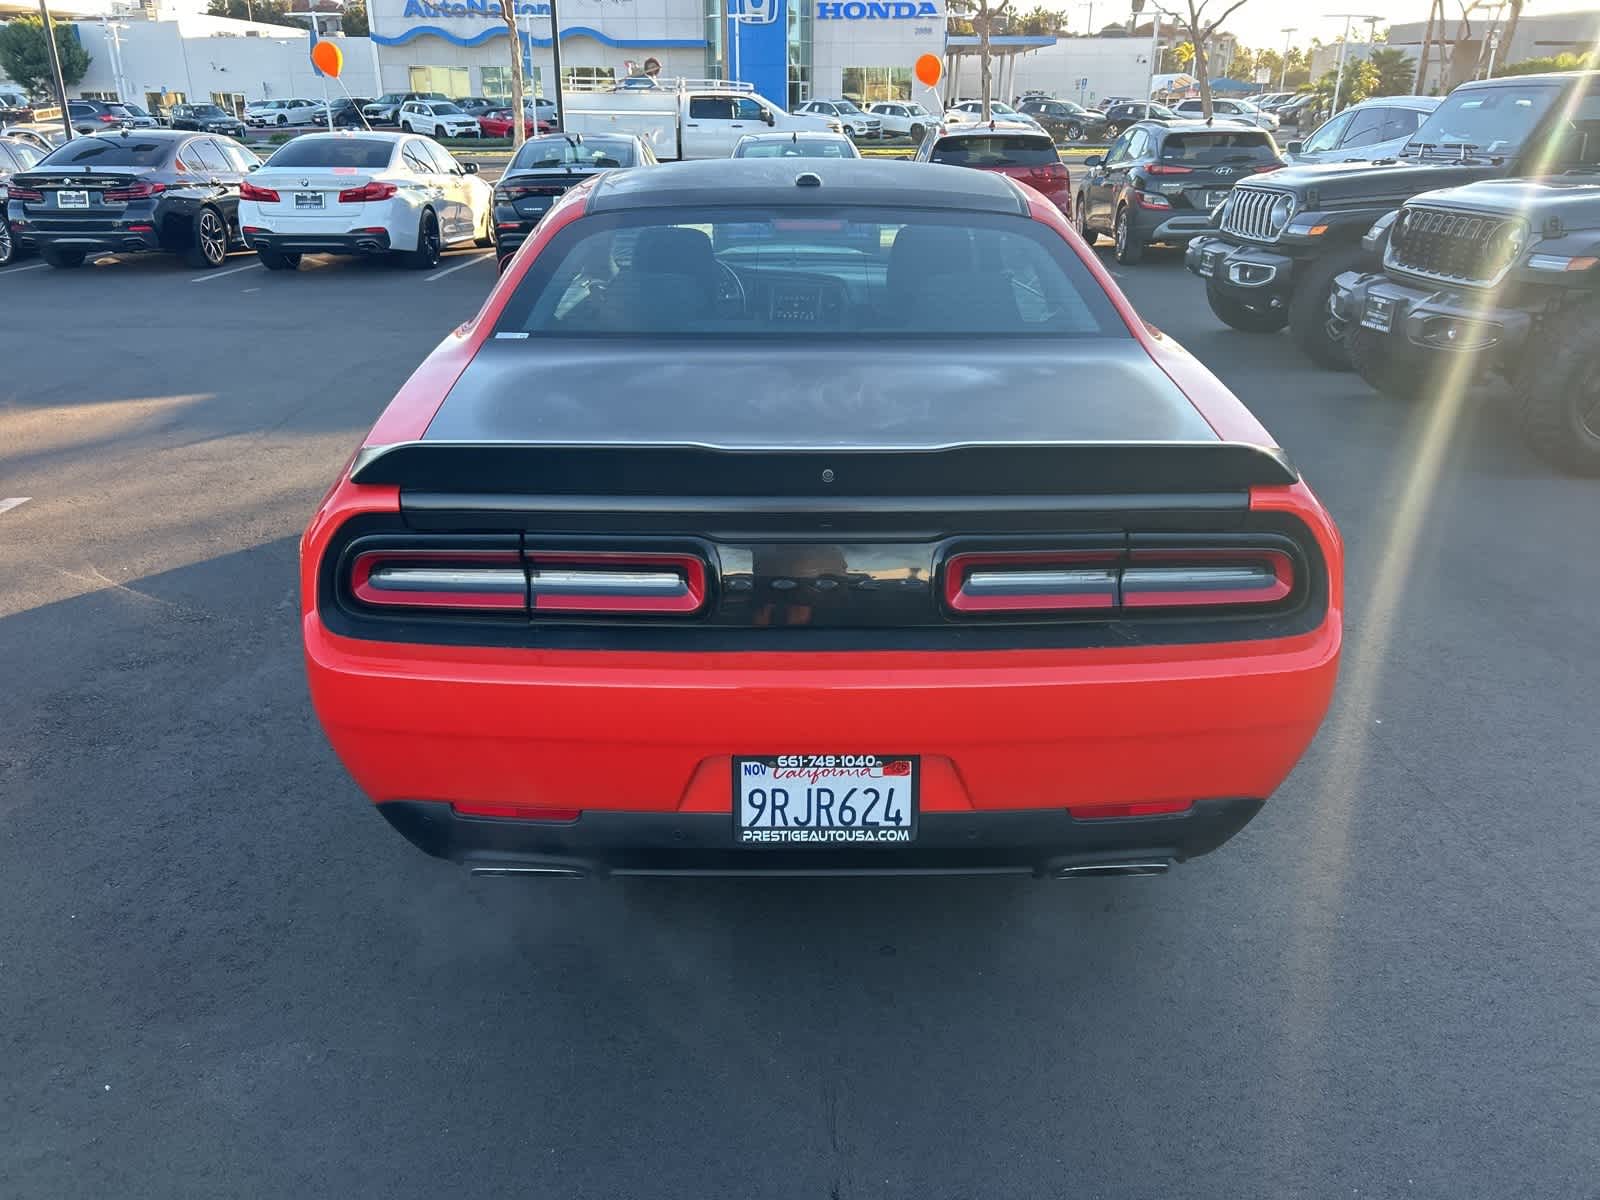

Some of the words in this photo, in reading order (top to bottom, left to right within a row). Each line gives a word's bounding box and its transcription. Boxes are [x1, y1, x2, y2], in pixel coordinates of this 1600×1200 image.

[404, 0, 551, 18] AutoNaion
[817, 2, 938, 19] HONDA
[777, 755, 876, 767] 661-748-1040
[744, 764, 767, 776] NOV
[772, 766, 880, 784] California
[748, 788, 903, 826] 9RJR624
[743, 830, 909, 841] PRESTIGEAUTOUSA.COM
